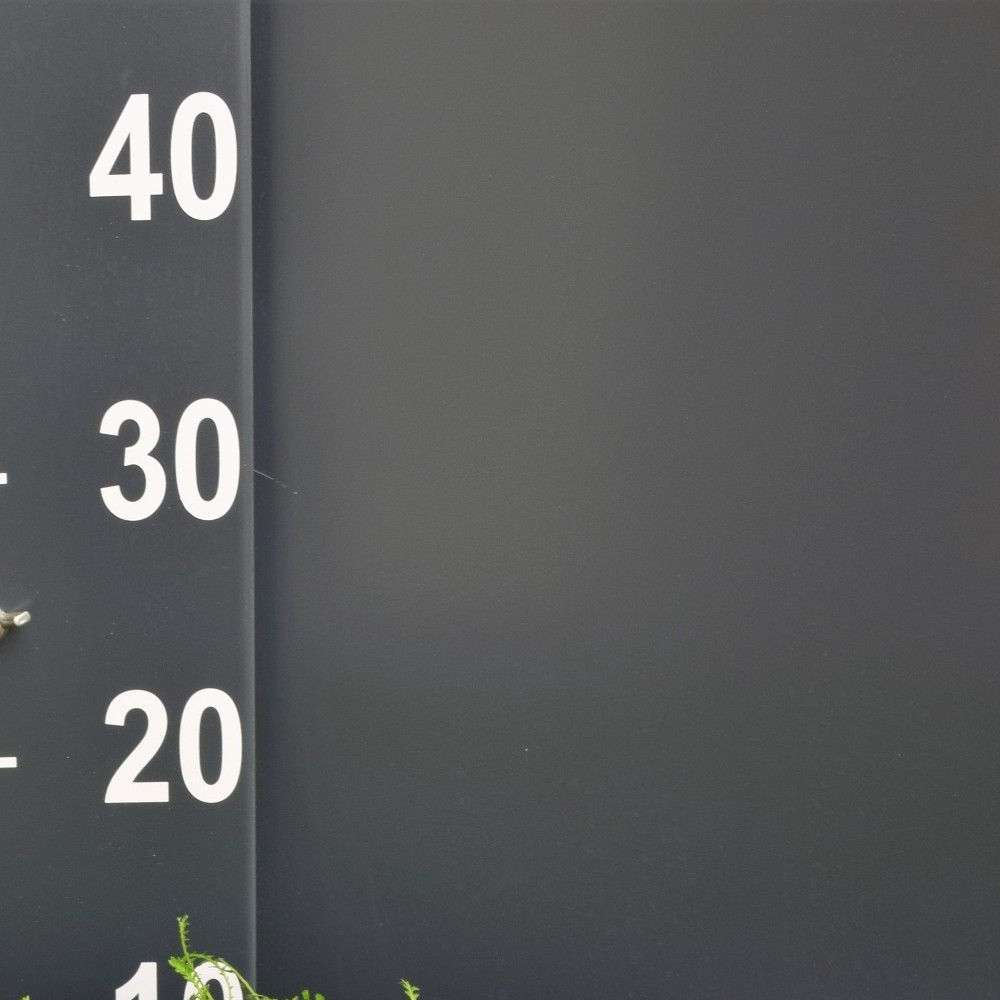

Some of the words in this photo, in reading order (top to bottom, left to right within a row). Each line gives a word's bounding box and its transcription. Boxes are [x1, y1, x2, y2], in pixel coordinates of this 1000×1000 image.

[89, 92, 239, 222] 40
[99, 398, 241, 521] 30
[104, 688, 243, 804] 20
